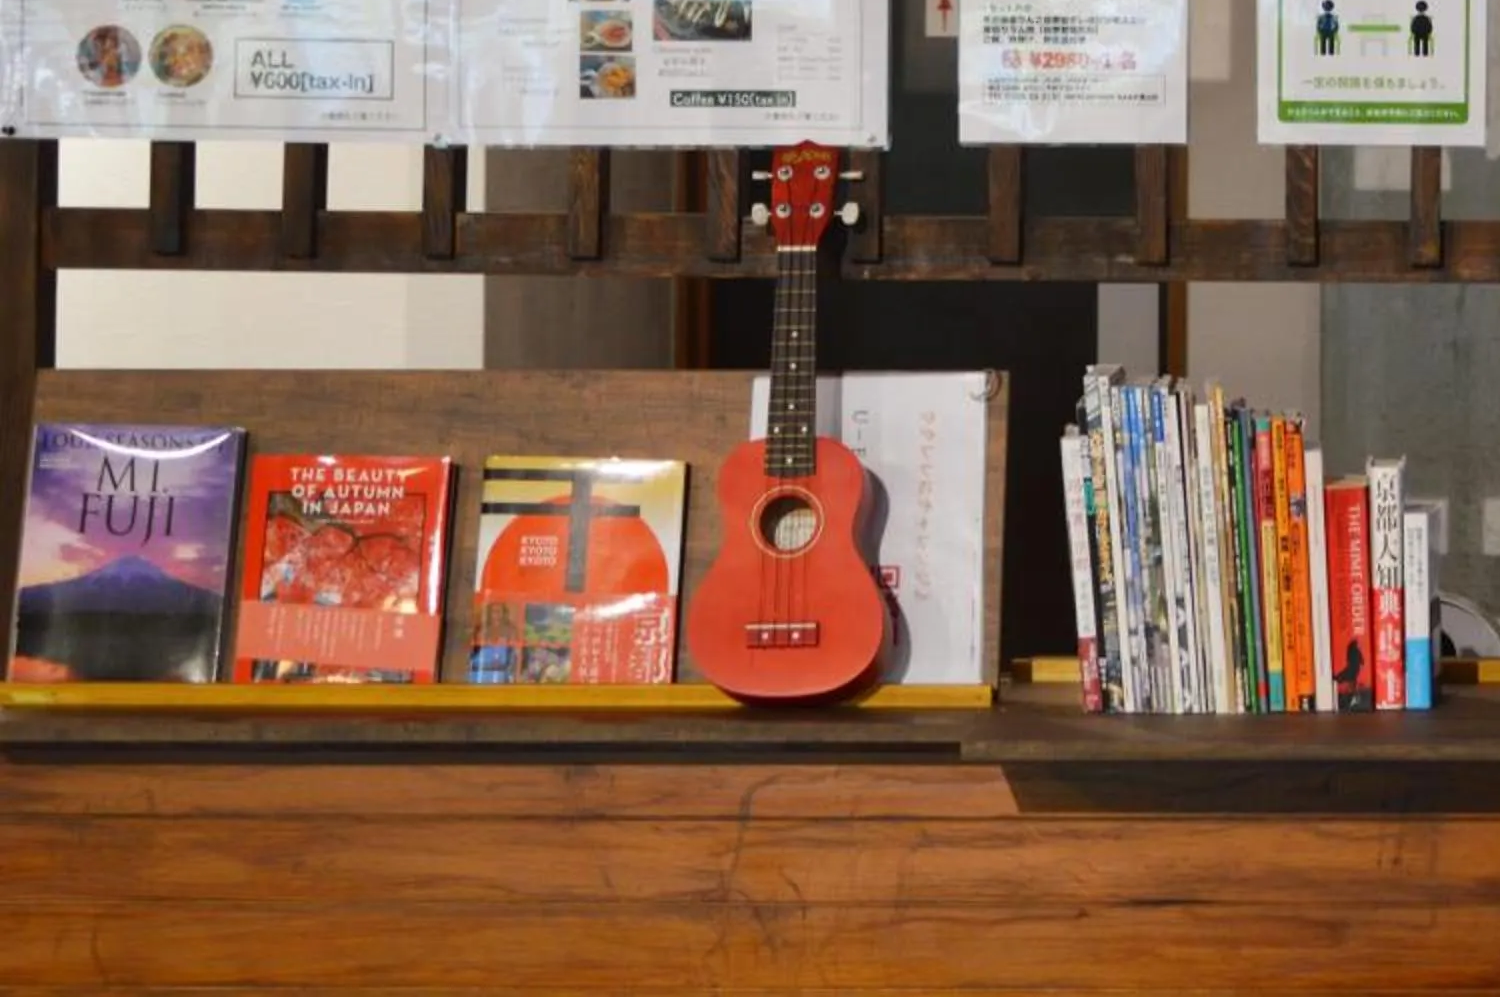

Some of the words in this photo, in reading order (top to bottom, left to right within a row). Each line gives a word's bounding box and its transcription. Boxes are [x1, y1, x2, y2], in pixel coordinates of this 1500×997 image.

[251, 50, 296, 69] ALL
[290, 467, 326, 482] THE
[333, 467, 408, 484] BEAUTY
[291, 485, 315, 498] OF
[323, 485, 404, 498] AUTUMN
[303, 502, 322, 515] IN
[329, 502, 391, 516] JAPAN
[1348, 504, 1362, 529] THE
[78, 492, 175, 547] FUJI
